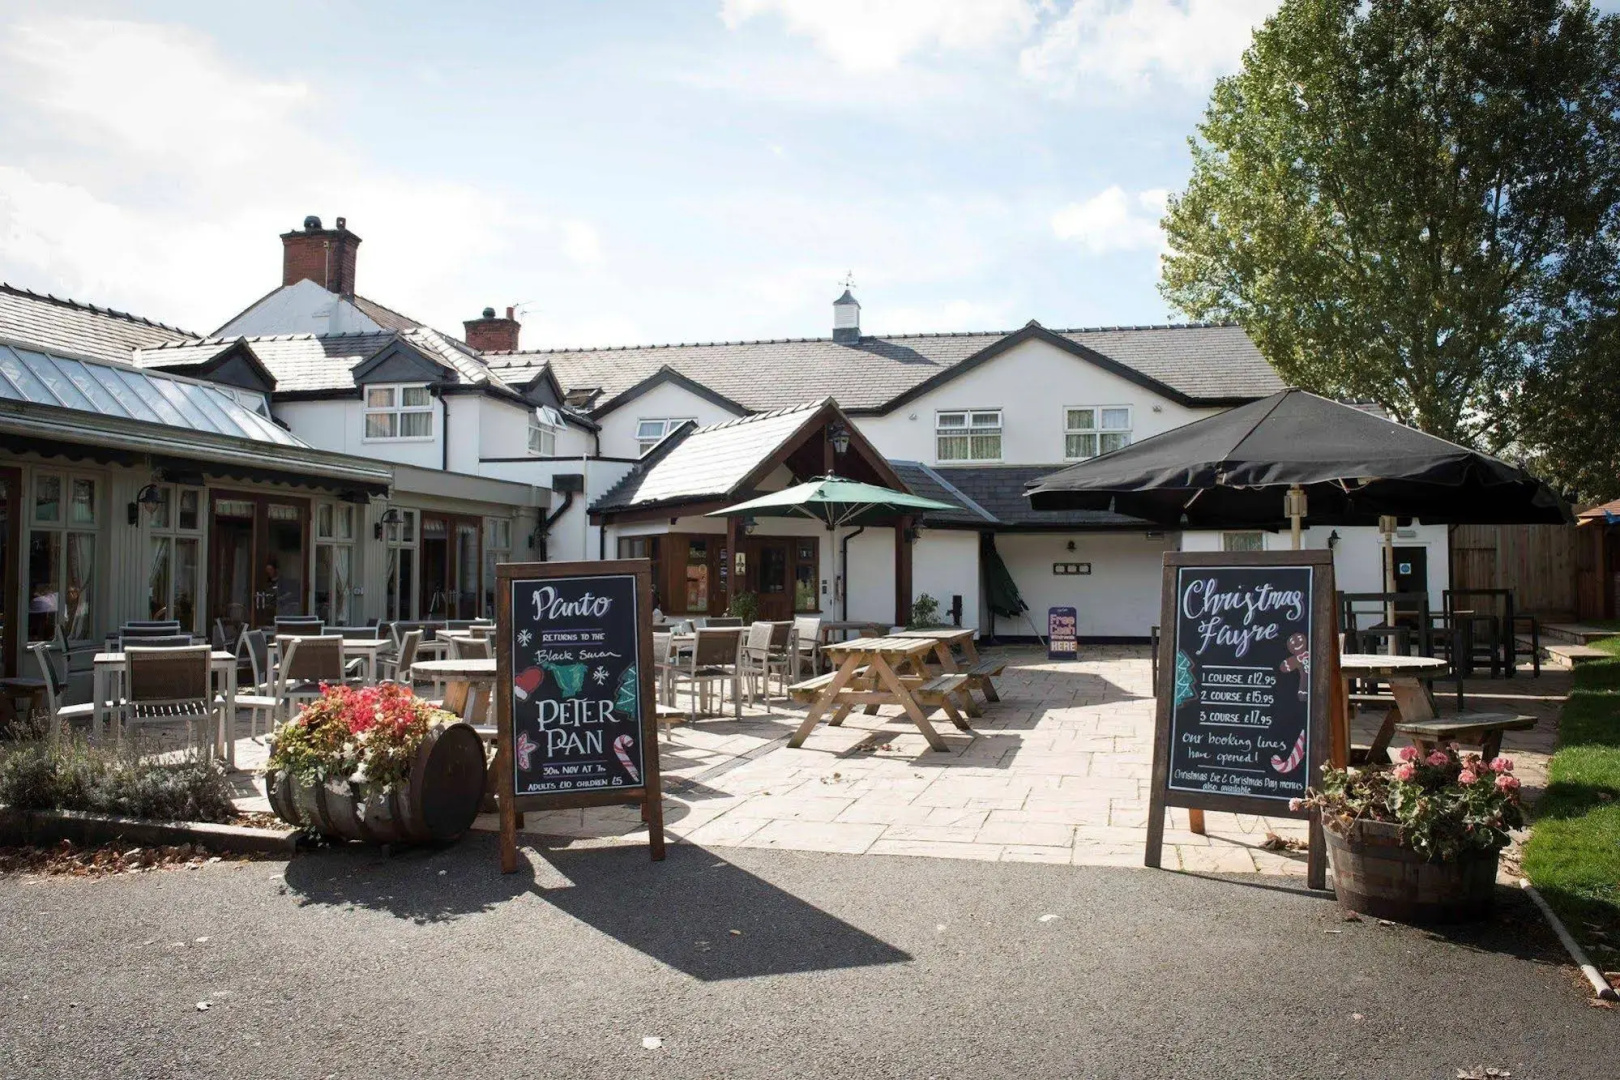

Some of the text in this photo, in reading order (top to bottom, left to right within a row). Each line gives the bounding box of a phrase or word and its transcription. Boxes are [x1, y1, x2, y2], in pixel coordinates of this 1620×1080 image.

[532, 586, 612, 620] Panto
[1183, 578, 1304, 625] Christmas
[1050, 614, 1075, 625] Free
[542, 632, 606, 642] RETURNS TO THE
[1196, 616, 1278, 658] Fayre
[1051, 641, 1077, 651] HERE
[535, 649, 622, 665] Black Swan
[1208, 674, 1244, 684] COURSE
[1247, 672, 1277, 685] £12.95
[1200, 690, 1275, 704] 2 COURSE £15.95
[535, 698, 621, 732] PETER
[1200, 710, 1273, 725] 3 COURSE £17.95
[545, 728, 604, 758] PAN
[1208, 732, 1252, 752] booking
[1257, 736, 1287, 750] lines
[1188, 747, 1211, 759] have
[562, 765, 580, 774] NOV
[582, 765, 593, 773] AT
[527, 776, 623, 791] ADULTS £10 CHILDREN £5
[1174, 769, 1208, 781] Christmas
[1209, 772, 1221, 783] Eve
[1229, 774, 1263, 787] Christmas
[1264, 777, 1278, 791] Day
[1279, 781, 1303, 790] menus
[1202, 782, 1252, 795] also available
